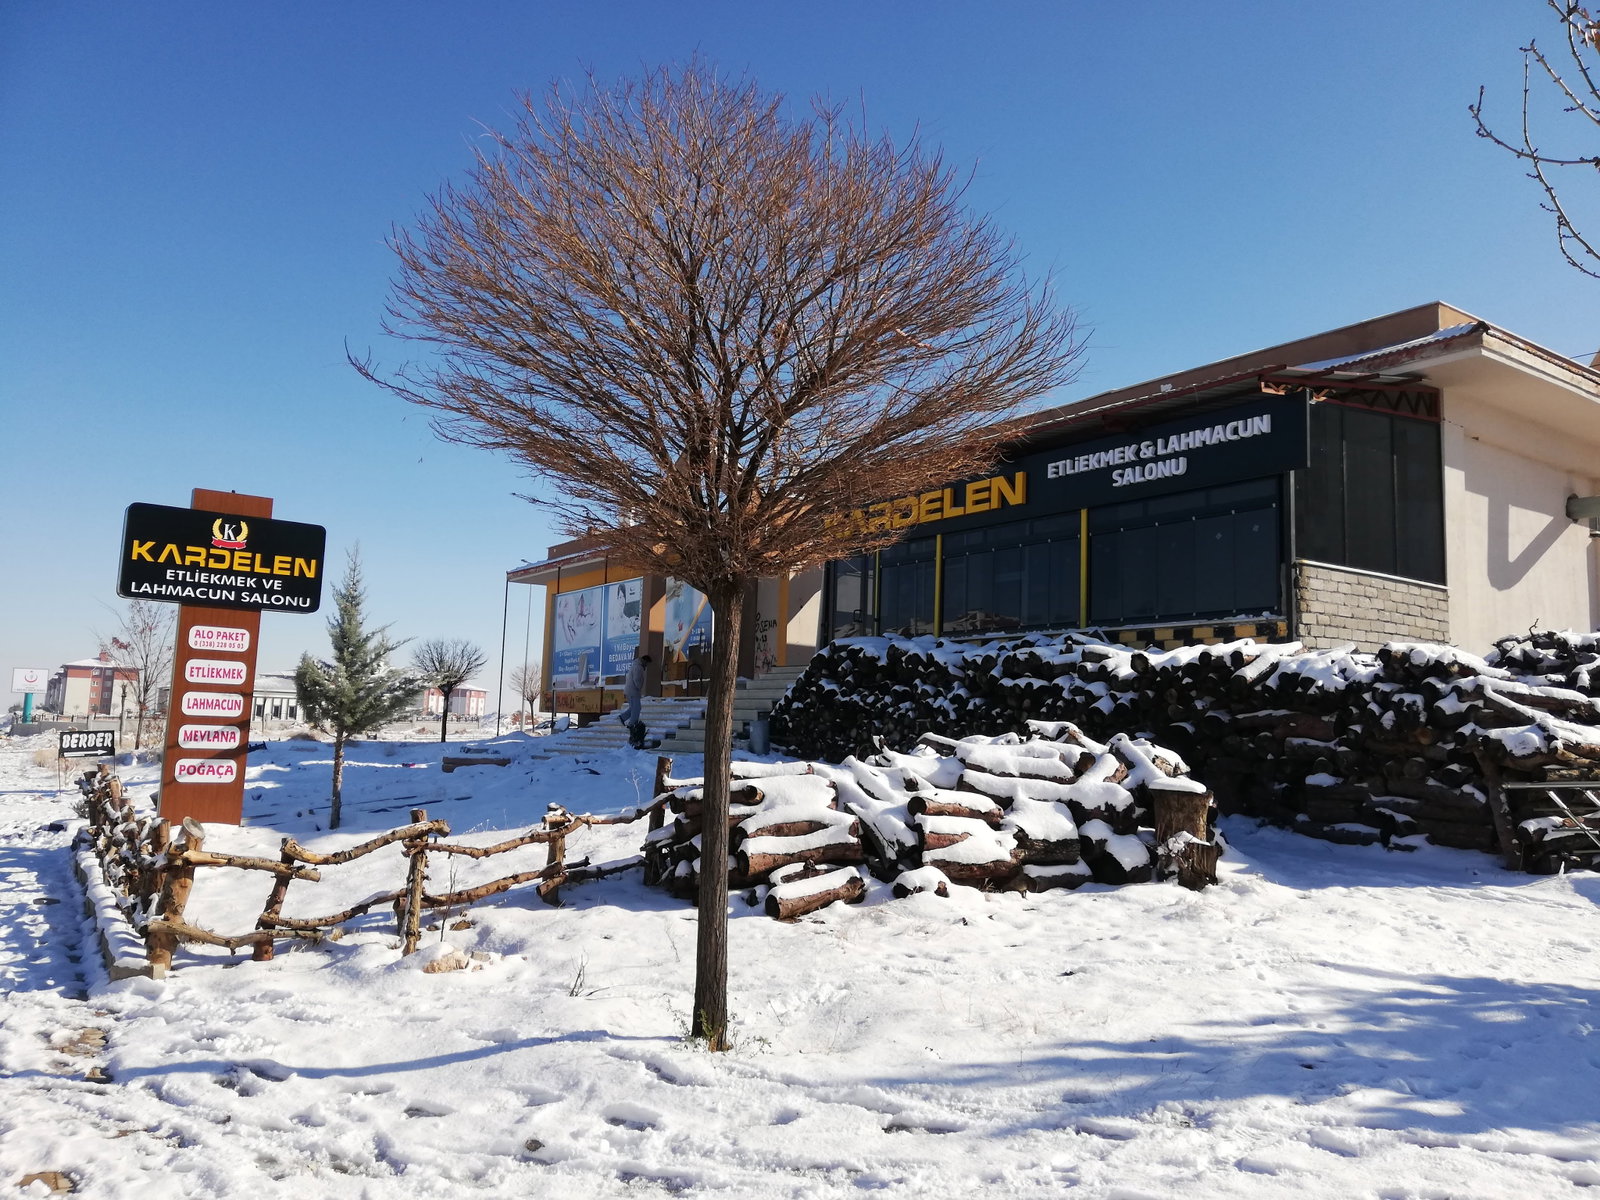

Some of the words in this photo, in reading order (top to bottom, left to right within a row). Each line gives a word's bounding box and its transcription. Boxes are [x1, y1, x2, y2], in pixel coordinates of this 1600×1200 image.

[1139, 440, 1156, 459] &
[1156, 414, 1272, 456] LAHMACUN
[1112, 456, 1188, 488] SALONU
[223, 523, 236, 541] K
[131, 539, 317, 579] KARDELEN
[166, 569, 257, 589] ETLİEKMEK
[262, 579, 283, 591] VE
[130, 581, 236, 601] LAHMACUN
[240, 592, 311, 608] SALONU
[194, 629, 214, 639] ALO
[216, 631, 246, 642] PAKET
[189, 664, 243, 680] ETLİEKMEK
[186, 697, 241, 711] LAHMACUN
[62, 732, 113, 749] BERBER
[183, 730, 236, 743] MEVLANA
[178, 763, 234, 779] POĞAÇA
